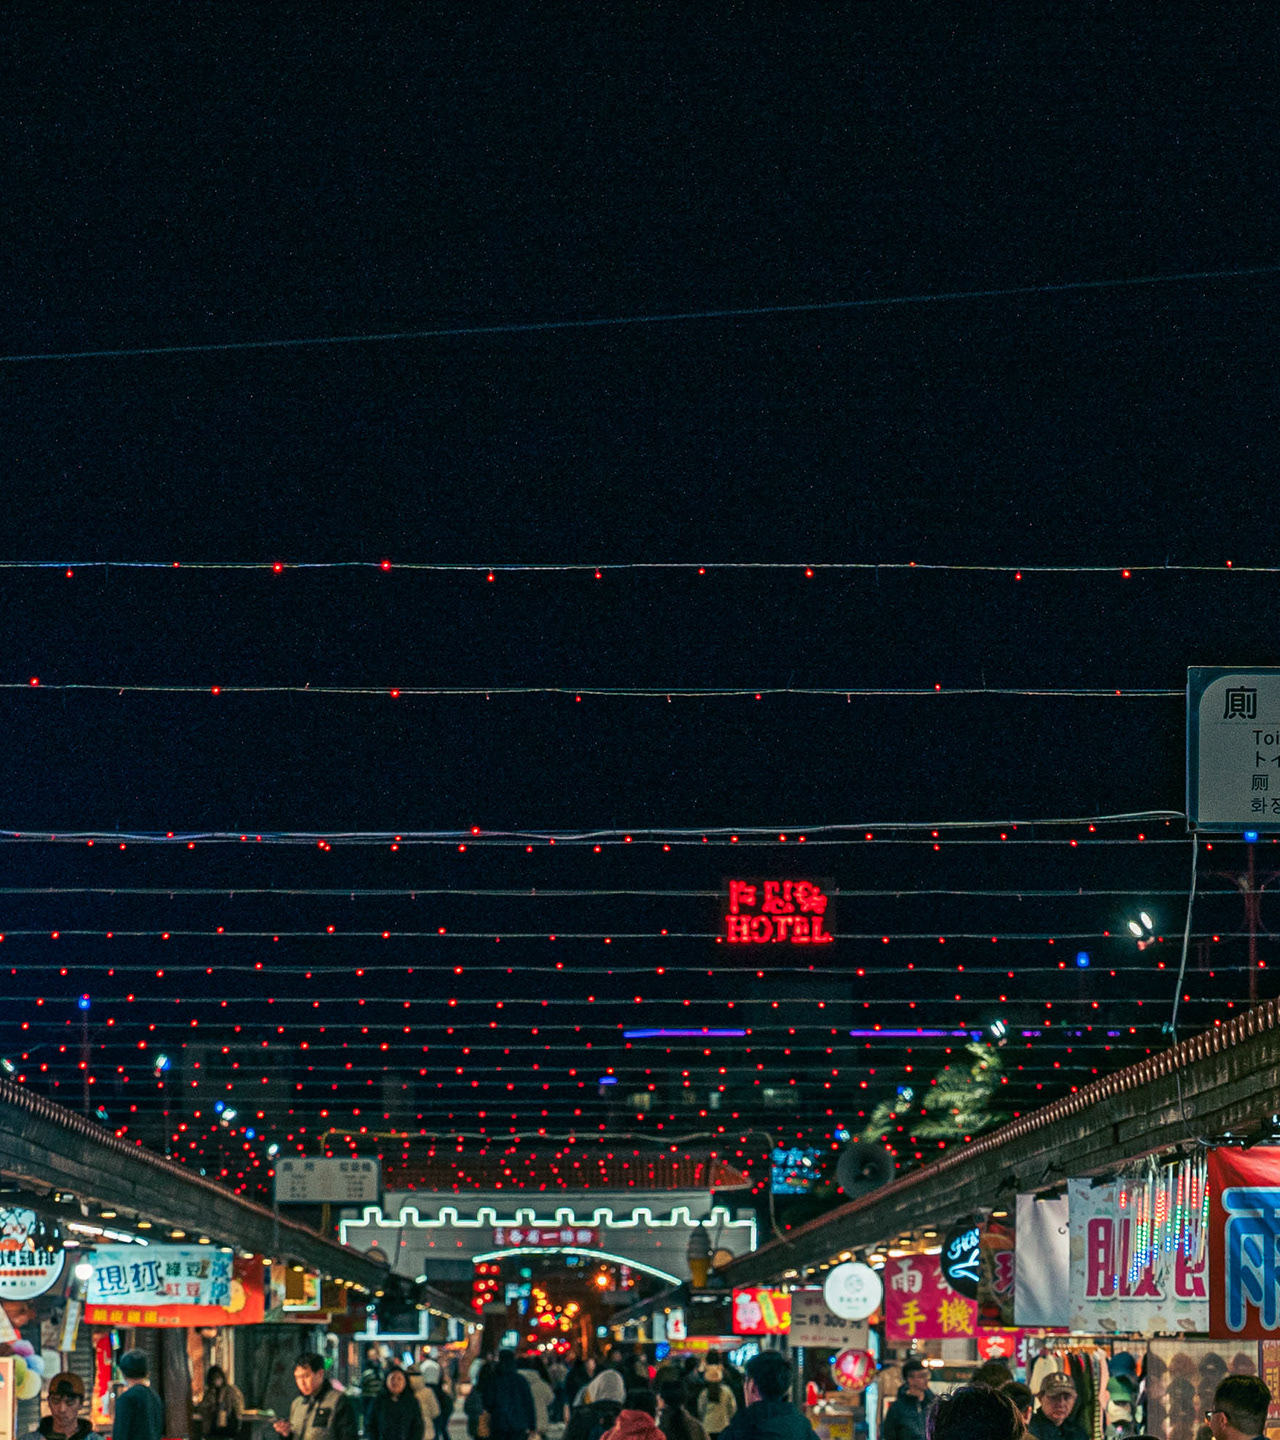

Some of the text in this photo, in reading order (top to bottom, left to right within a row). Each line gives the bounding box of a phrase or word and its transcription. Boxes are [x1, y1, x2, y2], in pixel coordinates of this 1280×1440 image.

[725, 914, 831, 943] HOTEL
[96, 1260, 158, 1295] 現打
[165, 1282, 201, 1297] 紅豆
[896, 1298, 975, 1337] 手機
